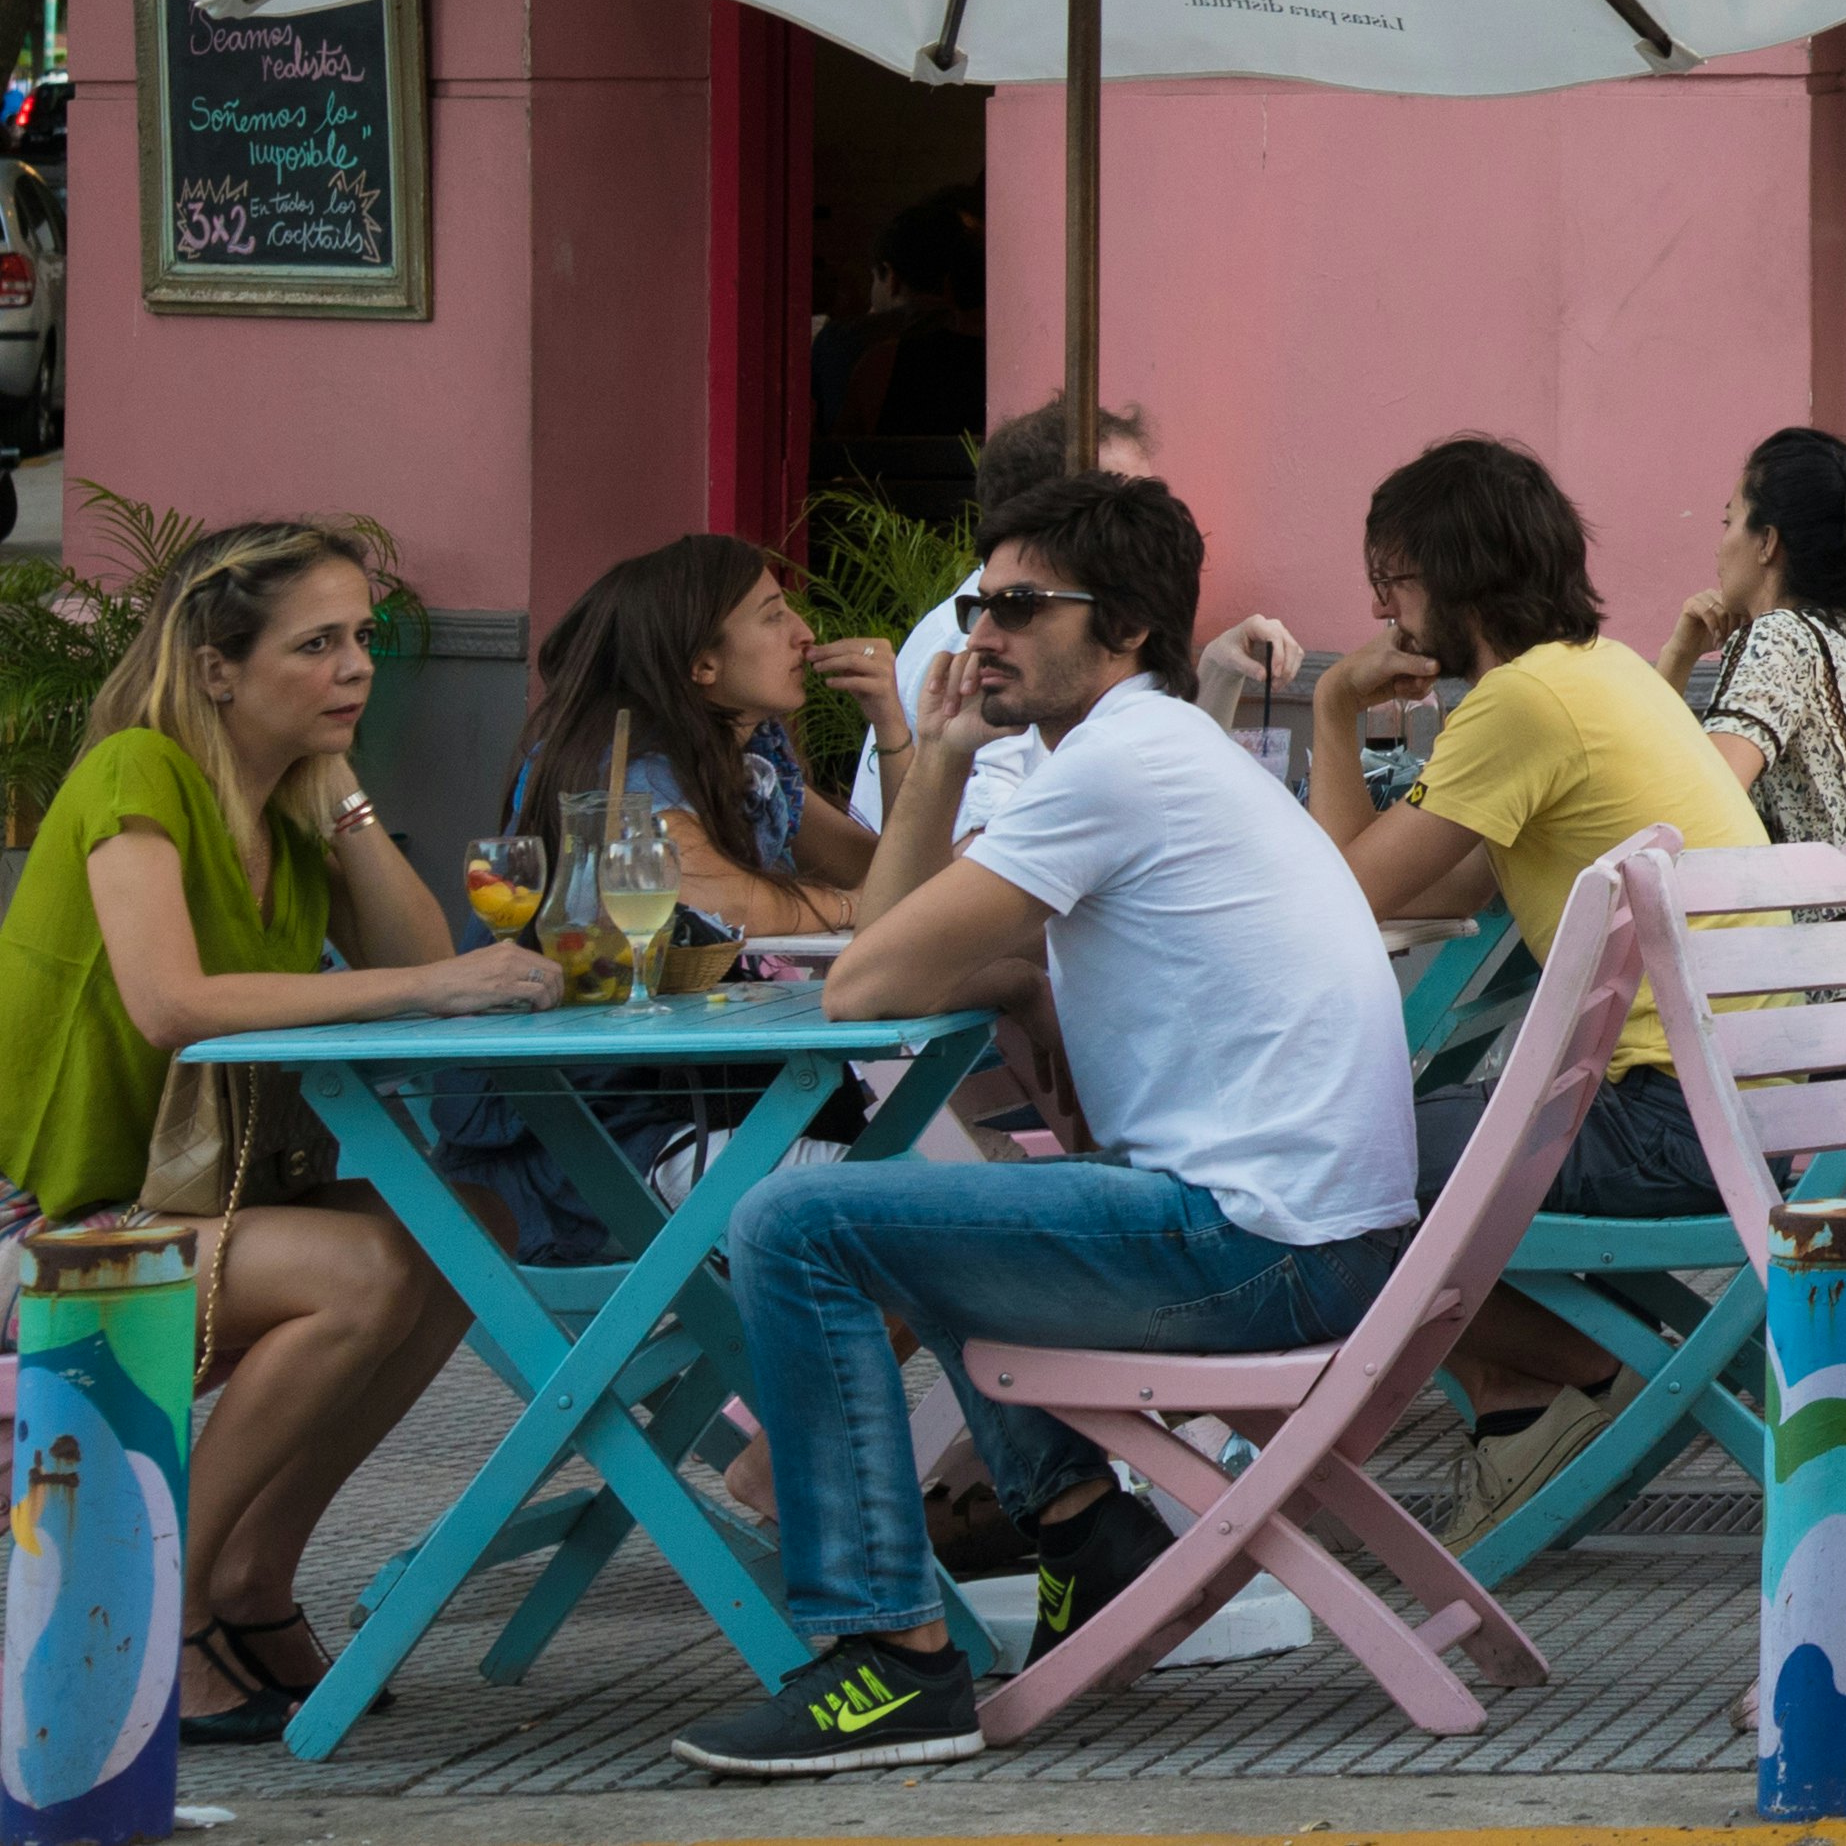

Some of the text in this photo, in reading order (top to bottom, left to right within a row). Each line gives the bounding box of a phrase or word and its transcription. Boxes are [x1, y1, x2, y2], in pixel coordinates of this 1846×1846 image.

[261, 35, 365, 83] realistas
[189, 90, 358, 134] Soñemos lo
[249, 186, 357, 218] En todos los
[187, 201, 256, 254] 3x2
